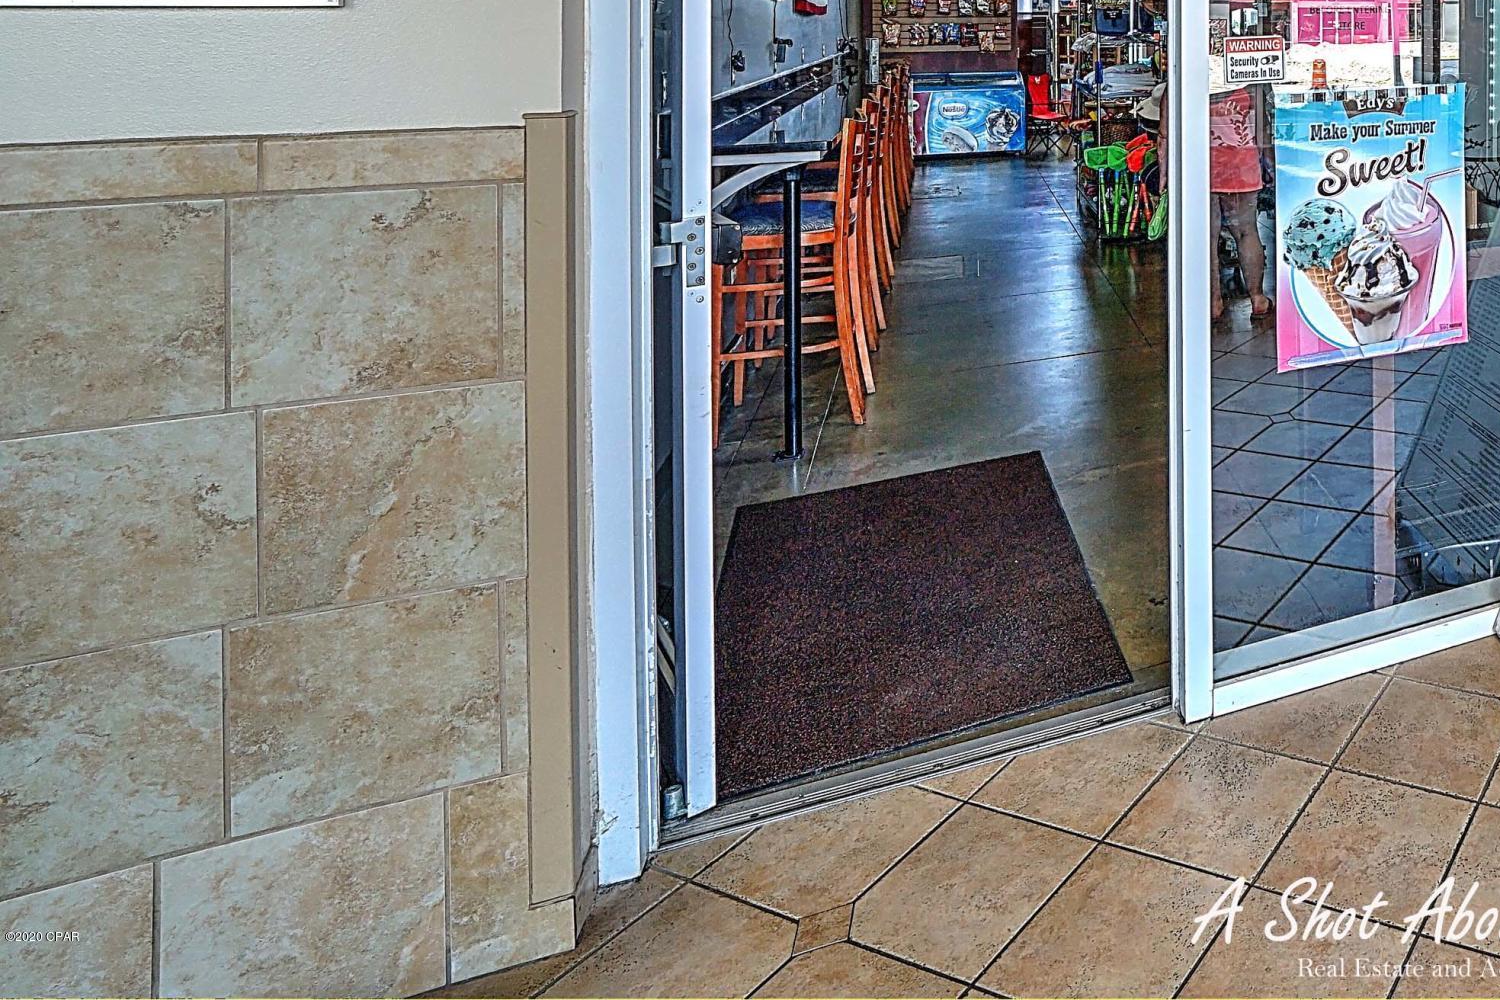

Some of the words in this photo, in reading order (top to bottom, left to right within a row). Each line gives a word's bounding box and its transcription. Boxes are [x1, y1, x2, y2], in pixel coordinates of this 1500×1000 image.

[1229, 39, 1280, 51] WARNING
[1230, 56, 1258, 67] Security
[1231, 69, 1259, 79] Cameras
[1260, 68, 1267, 78] In
[1268, 67, 1280, 77] Use
[1310, 123, 1348, 141] Make
[1352, 124, 1381, 142] your
[1385, 120, 1436, 136] Summer
[1317, 138, 1426, 197] Sweet!
